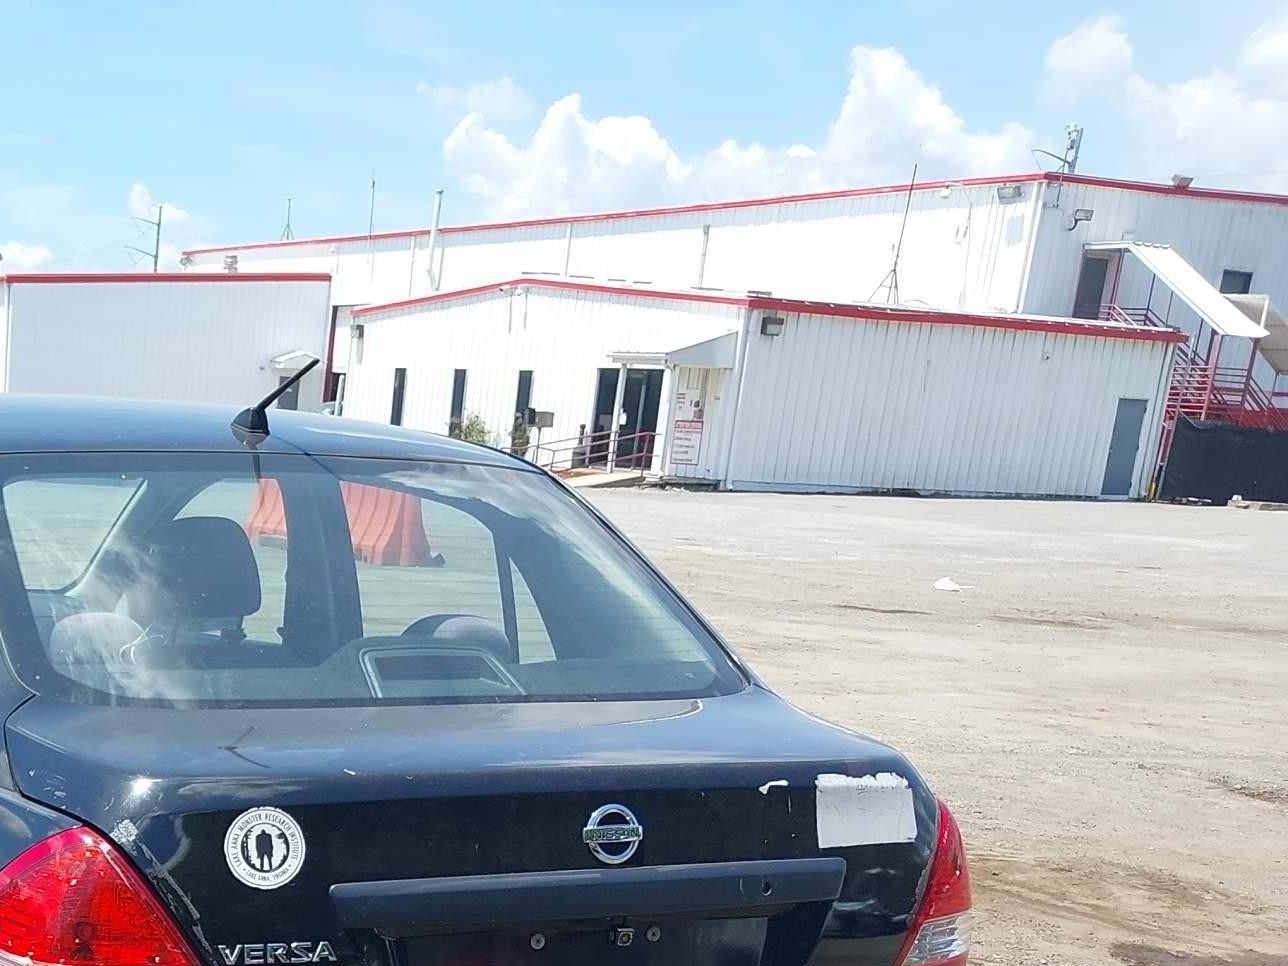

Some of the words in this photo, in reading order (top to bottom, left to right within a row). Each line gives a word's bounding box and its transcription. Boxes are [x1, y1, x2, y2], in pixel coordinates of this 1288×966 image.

[230, 833, 241, 850] ANNA
[238, 813, 262, 831] MONSTER
[265, 813, 292, 833] RESEARCH
[288, 832, 299, 860] INSTITUTE
[592, 829, 639, 840] NISSAN
[217, 941, 338, 966] VERSA
